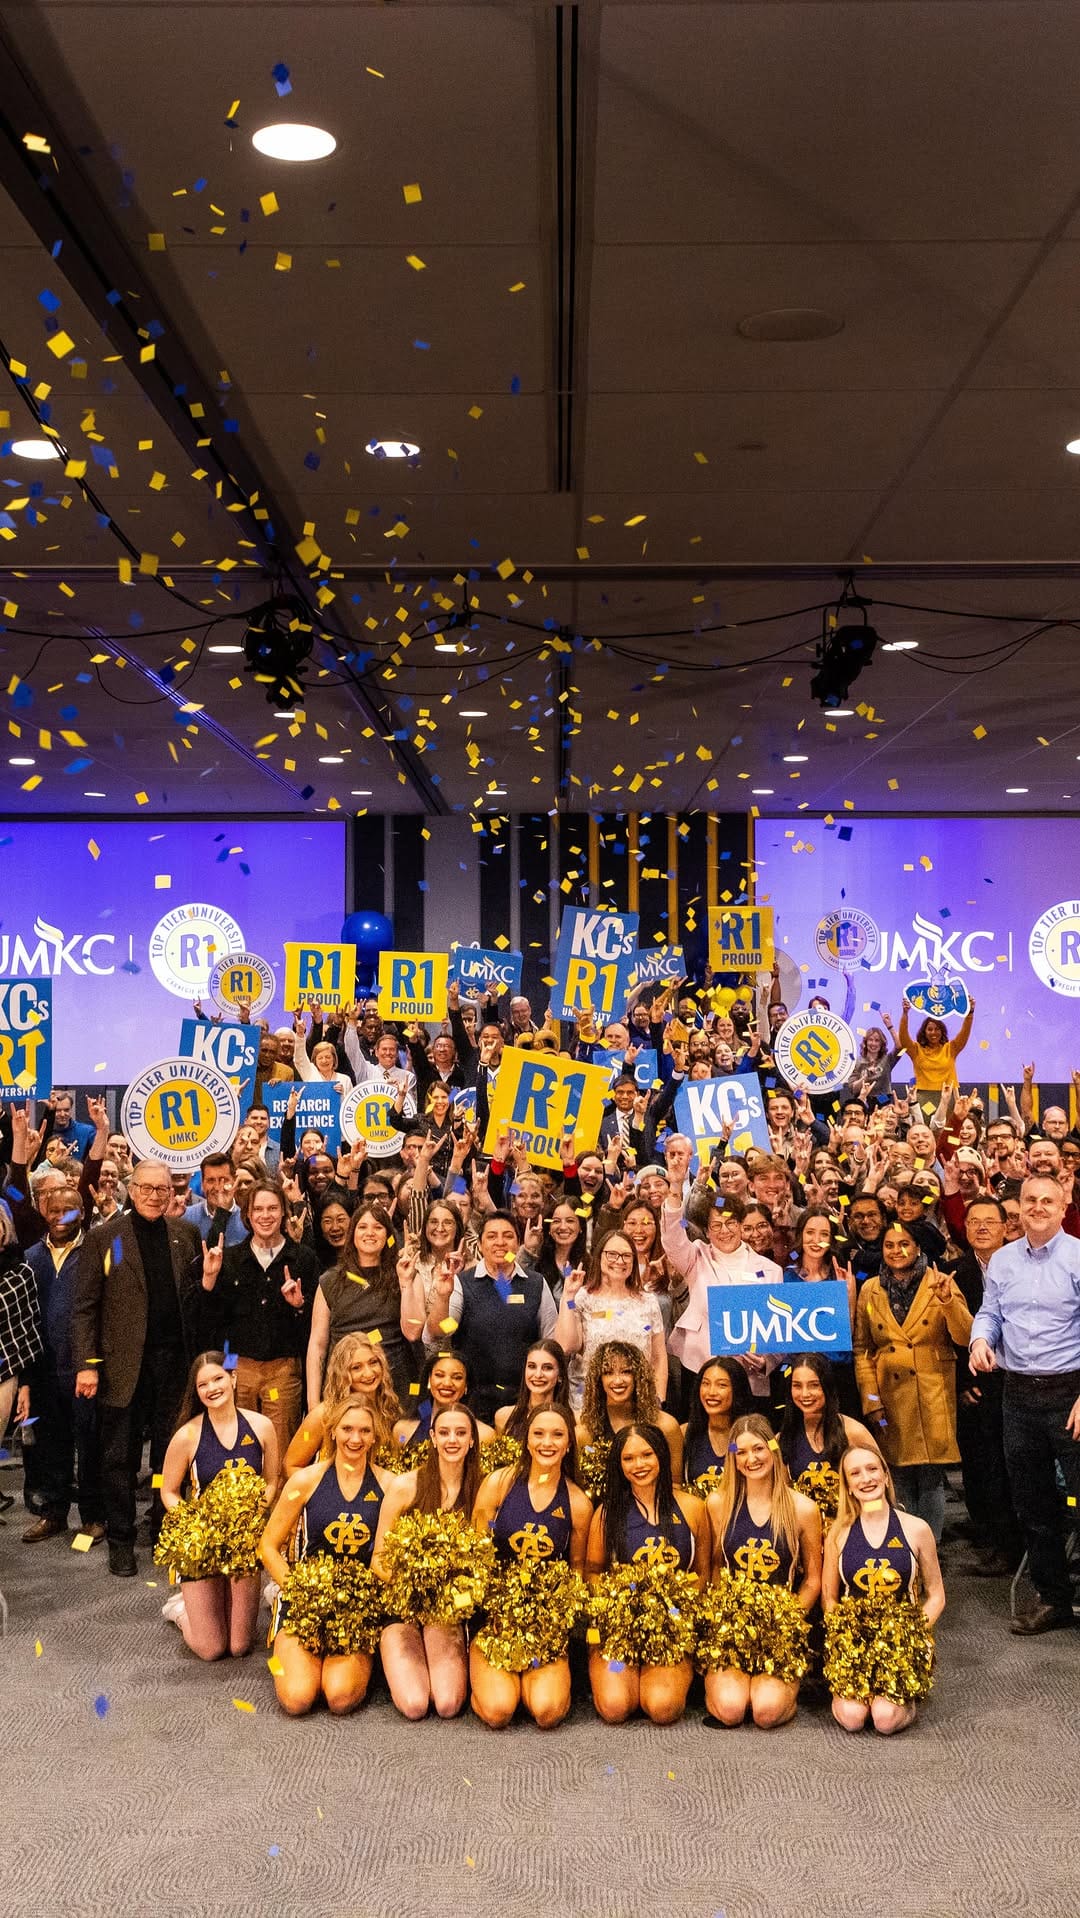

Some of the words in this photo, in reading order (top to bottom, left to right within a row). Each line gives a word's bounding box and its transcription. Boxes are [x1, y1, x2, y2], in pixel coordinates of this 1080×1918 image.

[152, 934, 164, 958] TOP
[160, 909, 187, 931] TIER
[192, 906, 243, 950] UNIVERSIT
[571, 912, 633, 960] KC's
[721, 912, 761, 950] R1
[1032, 931, 1044, 956] TOP
[1040, 906, 1067, 928] TIER
[180, 933, 216, 968] R1
[722, 953, 762, 966] PROUD
[230, 970, 253, 993] R1
[237, 955, 272, 990] UNIVERSITY
[299, 949, 342, 990] R1
[392, 958, 433, 999] R1
[460, 955, 515, 984] UMKC
[563, 957, 618, 1013] R1
[298, 992, 341, 1006] PROUD
[391, 1001, 433, 1015] PROUD
[562, 1007, 611, 1022] UNSITY
[192, 1025, 255, 1073] KC's
[780, 1036, 791, 1058] TIER
[795, 1030, 831, 1068] R1
[783, 1062, 800, 1081] TOP
[128, 1101, 143, 1129] TOP
[136, 1070, 165, 1097] TIER
[169, 1065, 232, 1116] UNIVERSITY
[159, 1089, 201, 1131] R1
[345, 1106, 355, 1125] TOP
[351, 1087, 370, 1105] TIER
[373, 1084, 413, 1118] UNIVESIT
[365, 1101, 393, 1128] R1
[511, 1061, 587, 1134] R1
[687, 1081, 762, 1136] KC's
[169, 1131, 199, 1146] UMKC
[269, 1114, 335, 1129] EXLLENCE
[149, 1146, 183, 1163] CARNEGIE
[186, 1138, 220, 1161] RESEARCH
[508, 1127, 562, 1158] PROU
[722, 1294, 838, 1344] UMKC
